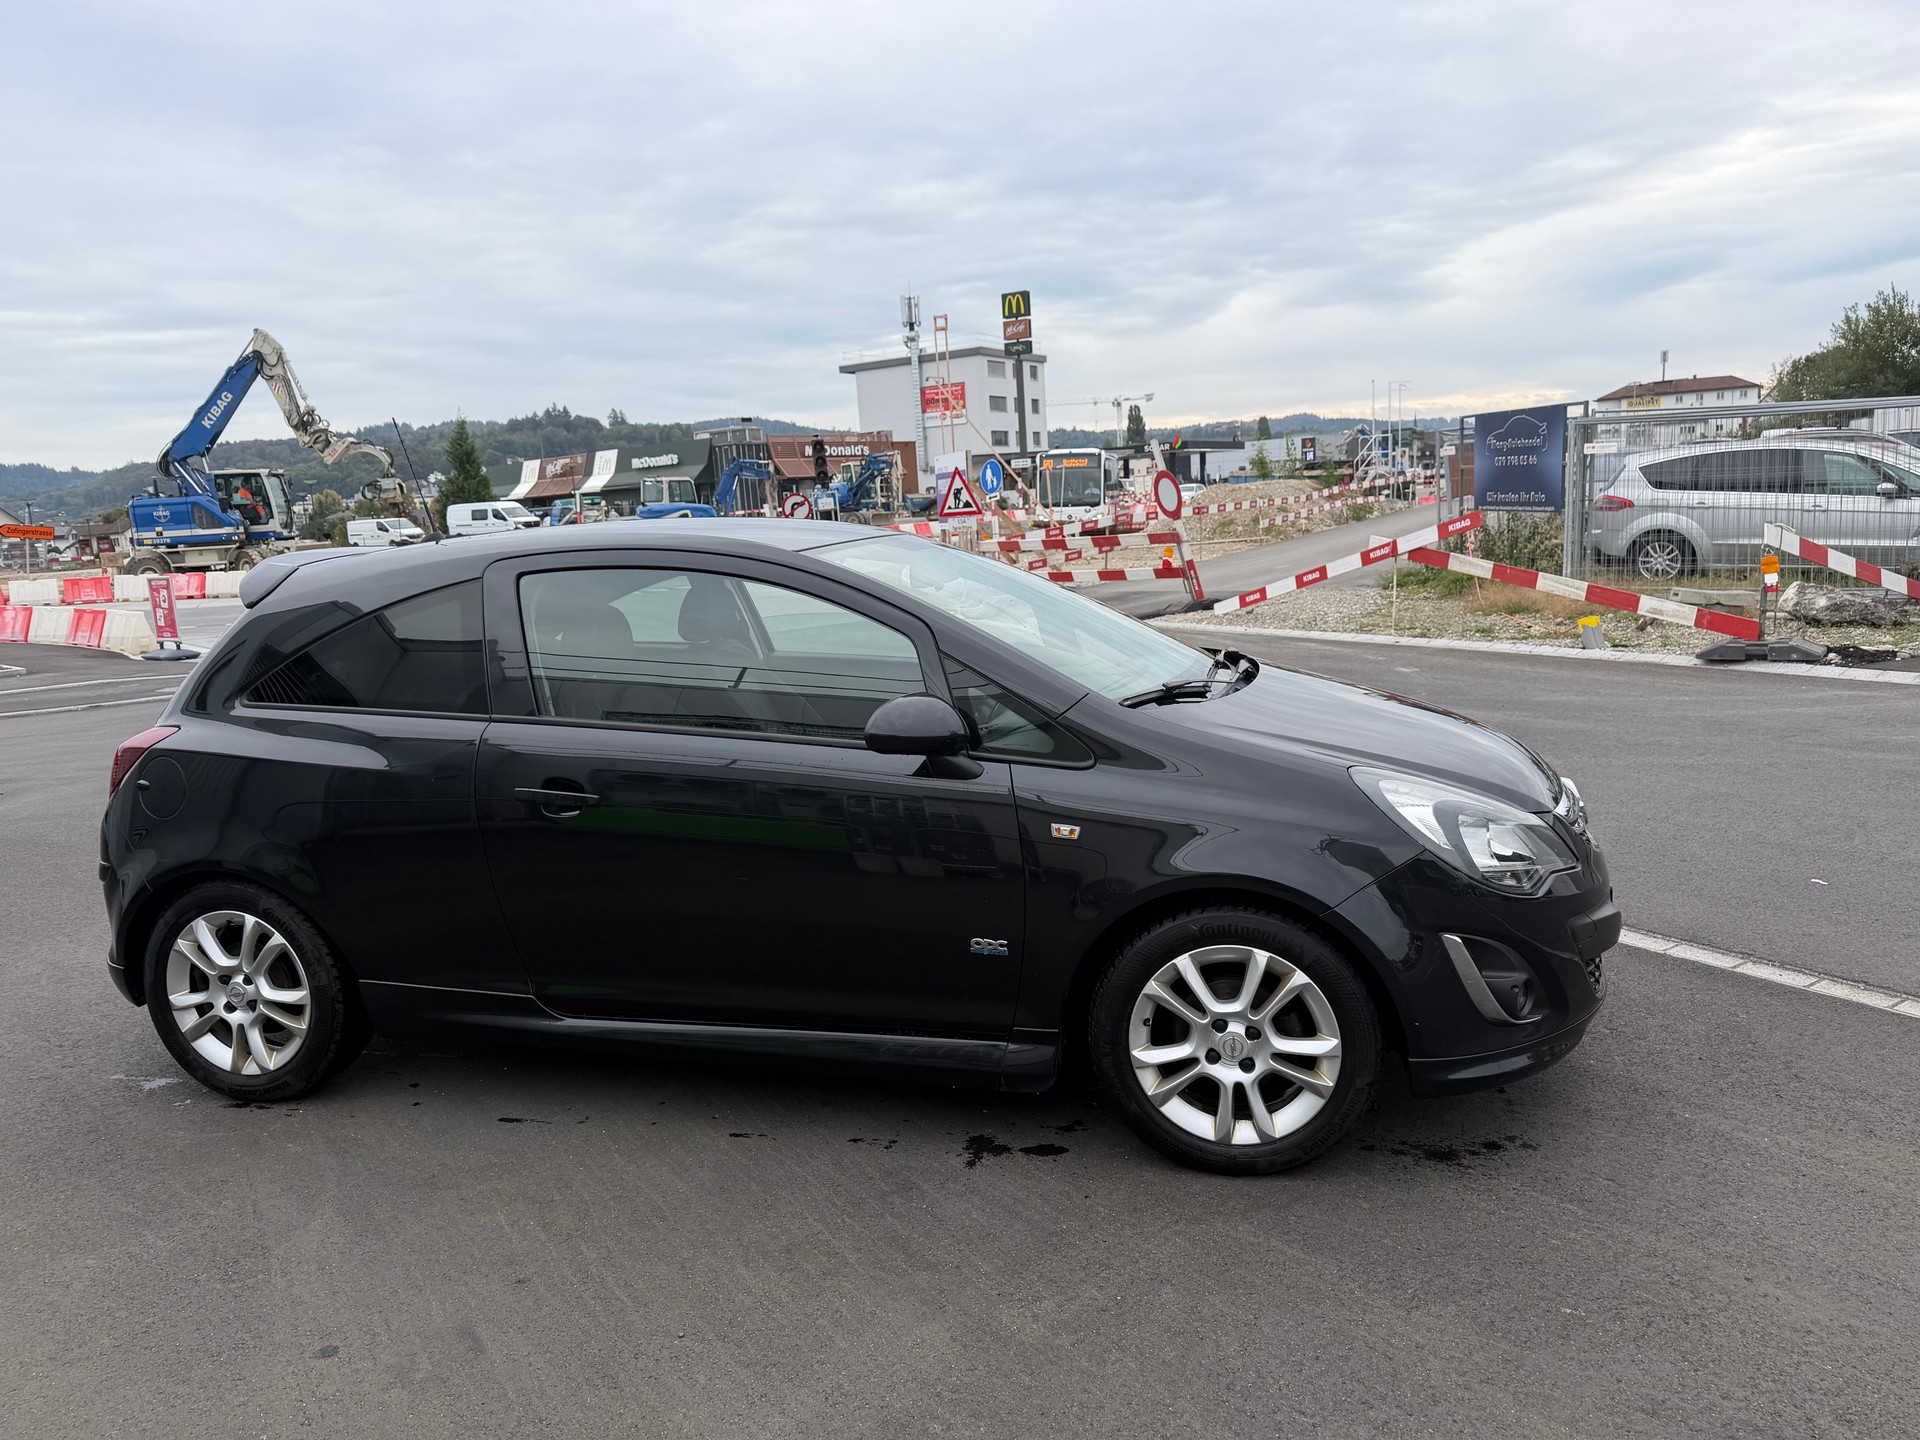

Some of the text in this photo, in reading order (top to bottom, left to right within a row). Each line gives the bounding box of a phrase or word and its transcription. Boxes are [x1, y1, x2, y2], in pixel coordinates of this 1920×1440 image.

[201, 391, 233, 429] KIBAG
[804, 444, 870, 457] MDonald's
[1143, 443, 1170, 453] SOAR
[631, 453, 679, 469] McDonald's
[6, 526, 53, 537] Zofingerstrasse
[1448, 518, 1471, 532] KIBAG
[1369, 547, 1389, 560] KIBAG
[1302, 571, 1320, 582] KIBAG
[1245, 592, 1261, 602] KIBAG
